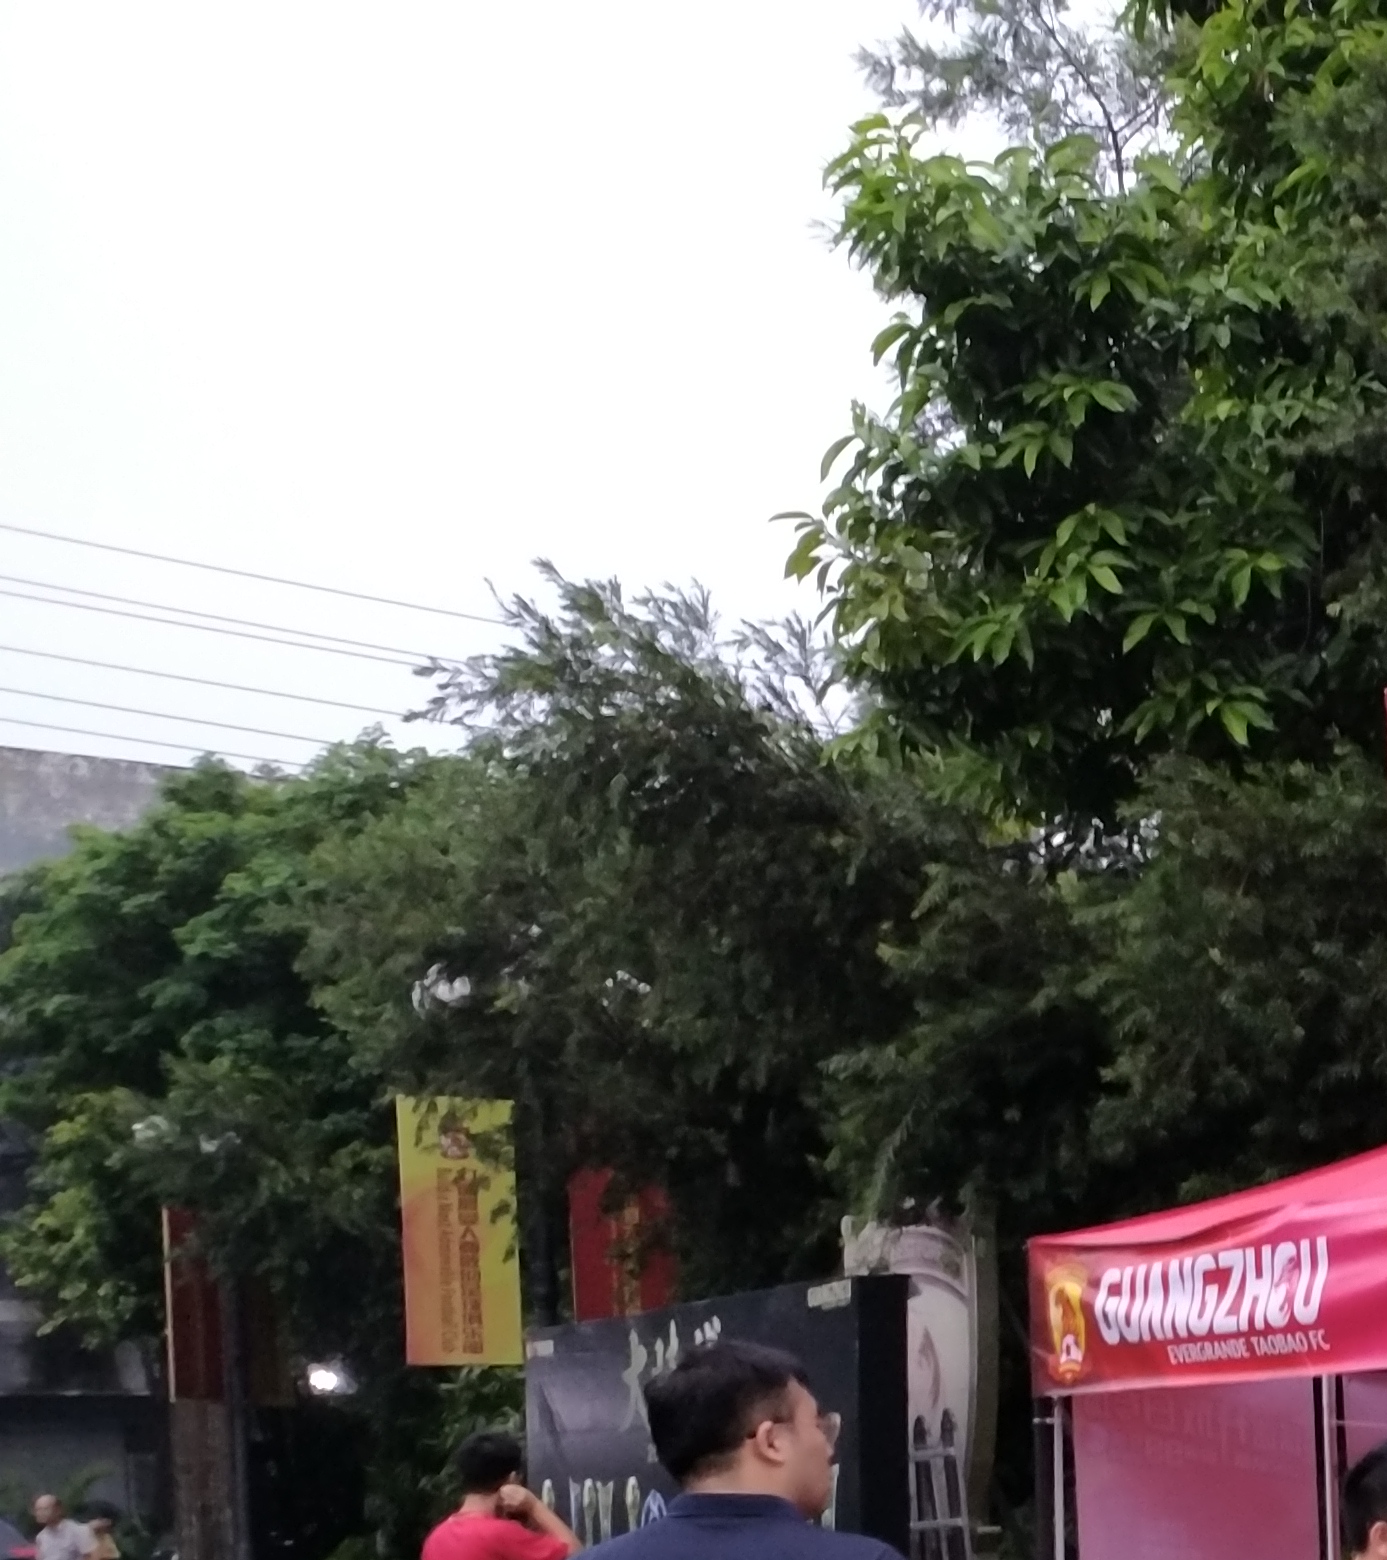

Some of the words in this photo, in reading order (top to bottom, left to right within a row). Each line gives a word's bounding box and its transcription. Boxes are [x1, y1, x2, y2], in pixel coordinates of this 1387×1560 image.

[1094, 1236, 1329, 1346] GUANGZHOU
[1167, 1338, 1250, 1366] EVERGRANDE
[1250, 1331, 1308, 1357] TAOBAO
[1308, 1329, 1331, 1351] FC
